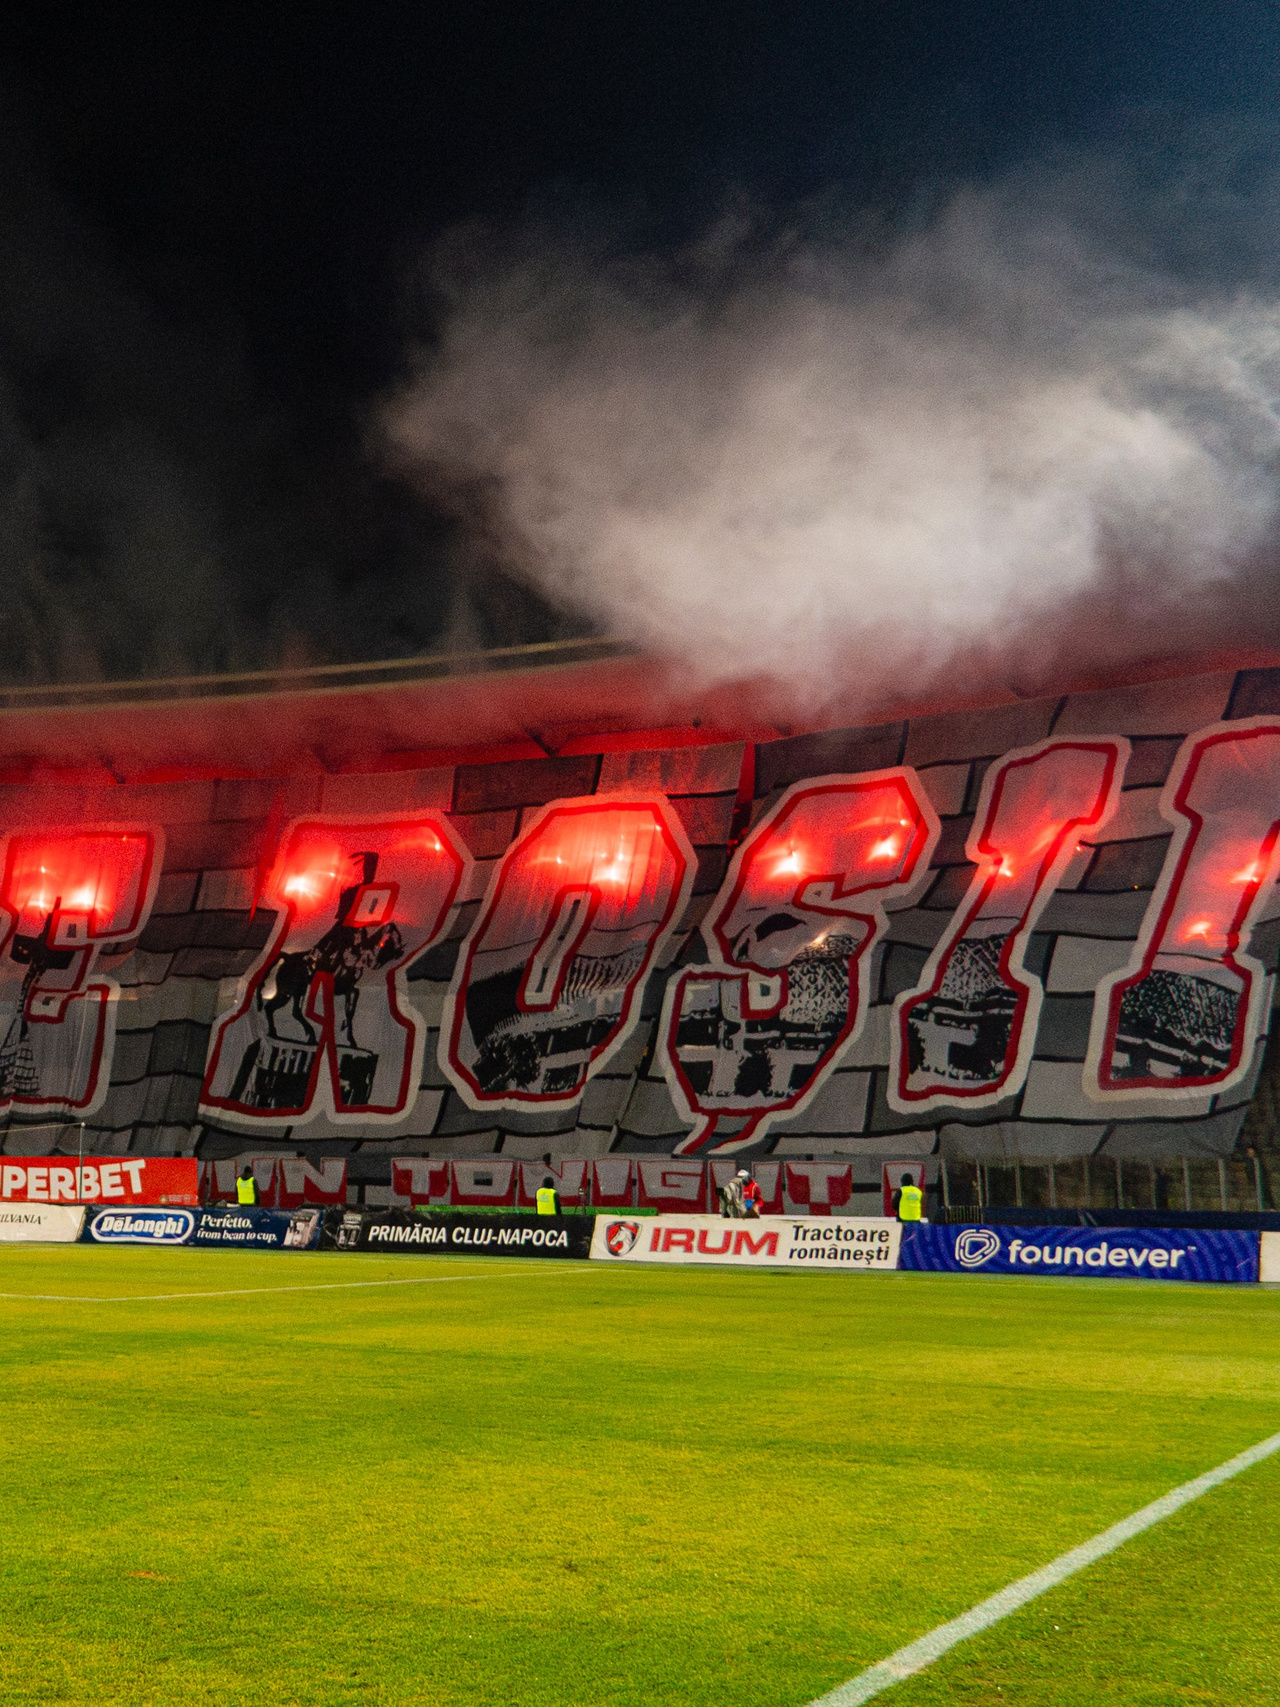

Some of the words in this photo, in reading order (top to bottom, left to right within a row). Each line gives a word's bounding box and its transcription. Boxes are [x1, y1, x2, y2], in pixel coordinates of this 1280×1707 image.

[197, 1228, 221, 1240] from
[222, 1229, 245, 1240] bean
[246, 1231, 256, 1240] to
[256, 1232, 278, 1244] cup.
[368, 1223, 447, 1244] PRIMĂRIA
[451, 1228, 569, 1248] CLUJ-NAPOCA
[649, 1227, 780, 1256] IRUM
[792, 1224, 890, 1243] Tractoare
